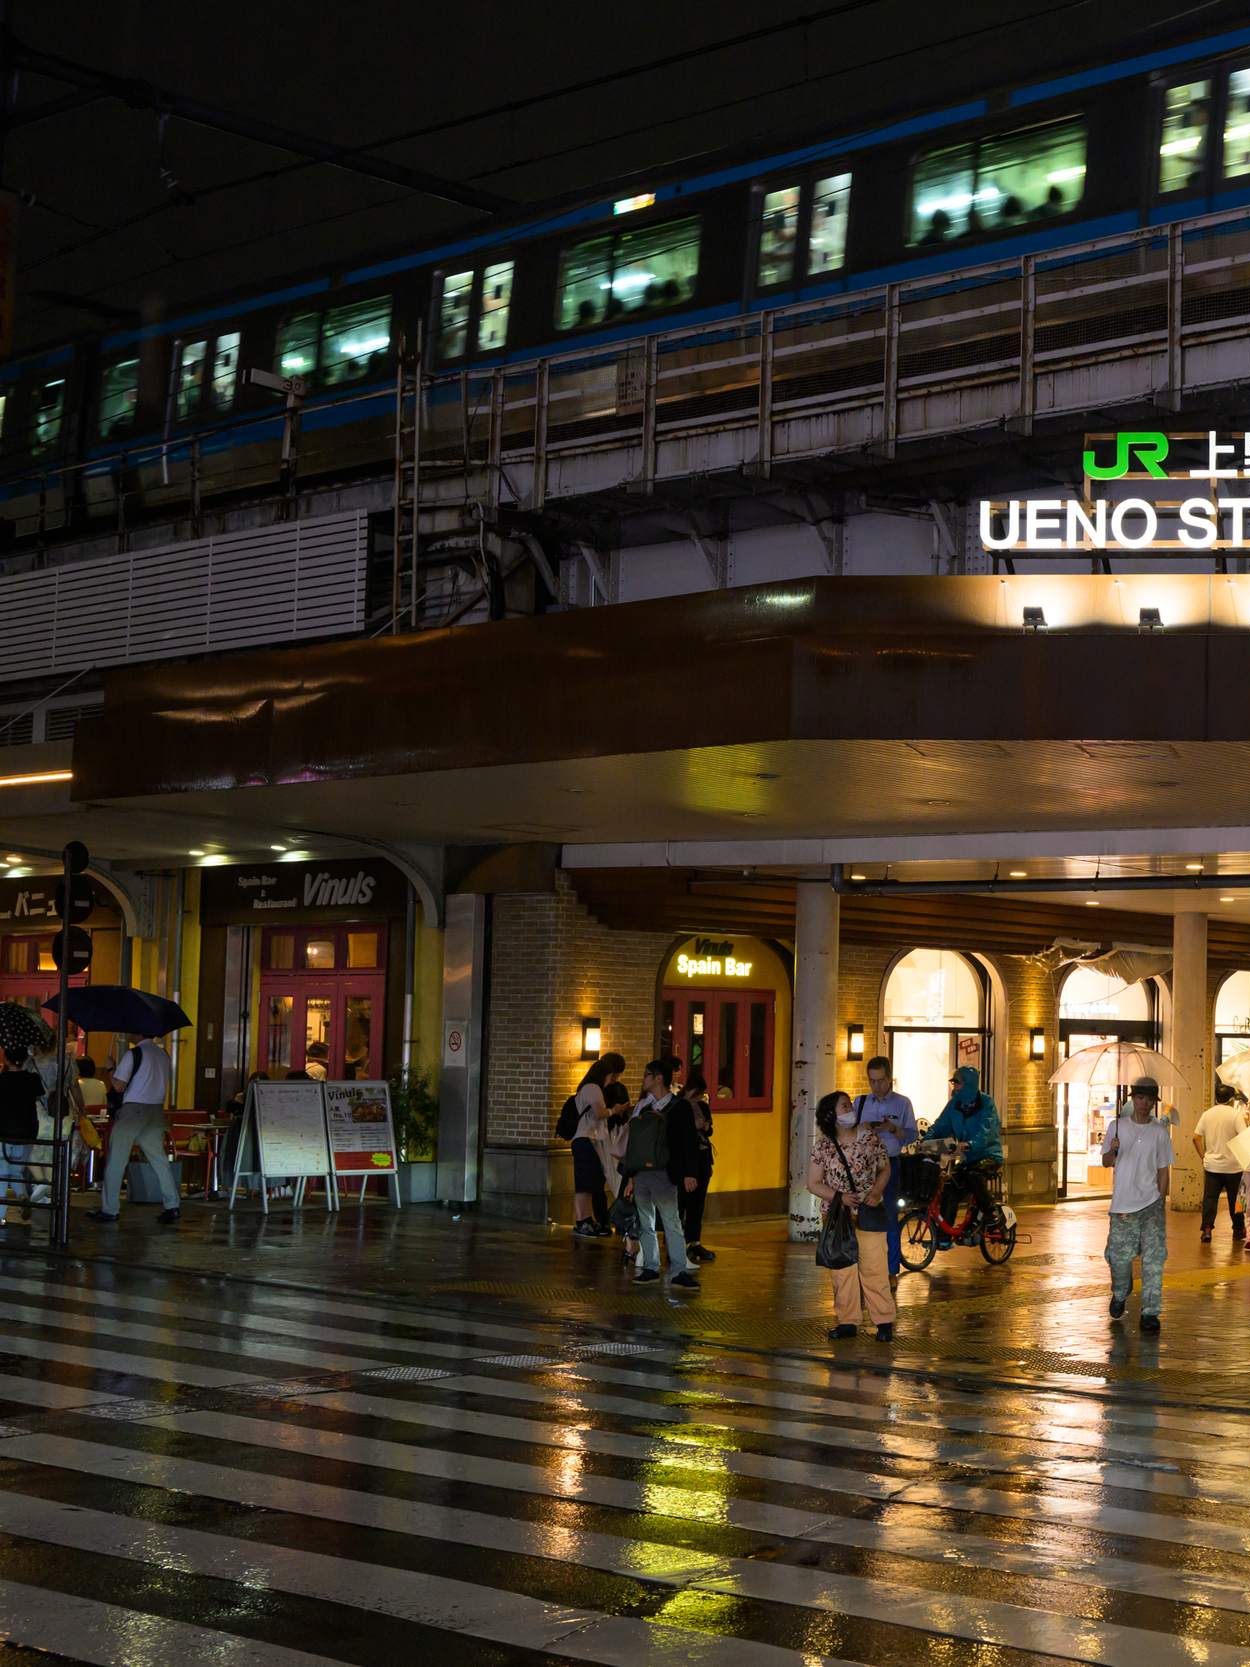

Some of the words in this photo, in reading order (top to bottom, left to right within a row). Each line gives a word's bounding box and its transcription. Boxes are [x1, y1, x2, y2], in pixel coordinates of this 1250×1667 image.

[1083, 432, 1169, 479] JR
[979, 498, 1158, 549] UENO
[238, 876, 262, 888] Spain
[262, 876, 277, 886] Bar
[303, 871, 376, 906] Vinuls
[253, 897, 298, 909] Restaurant
[677, 954, 721, 978] Spain
[725, 957, 752, 976] Bar
[328, 1087, 362, 1101] Vinuls
